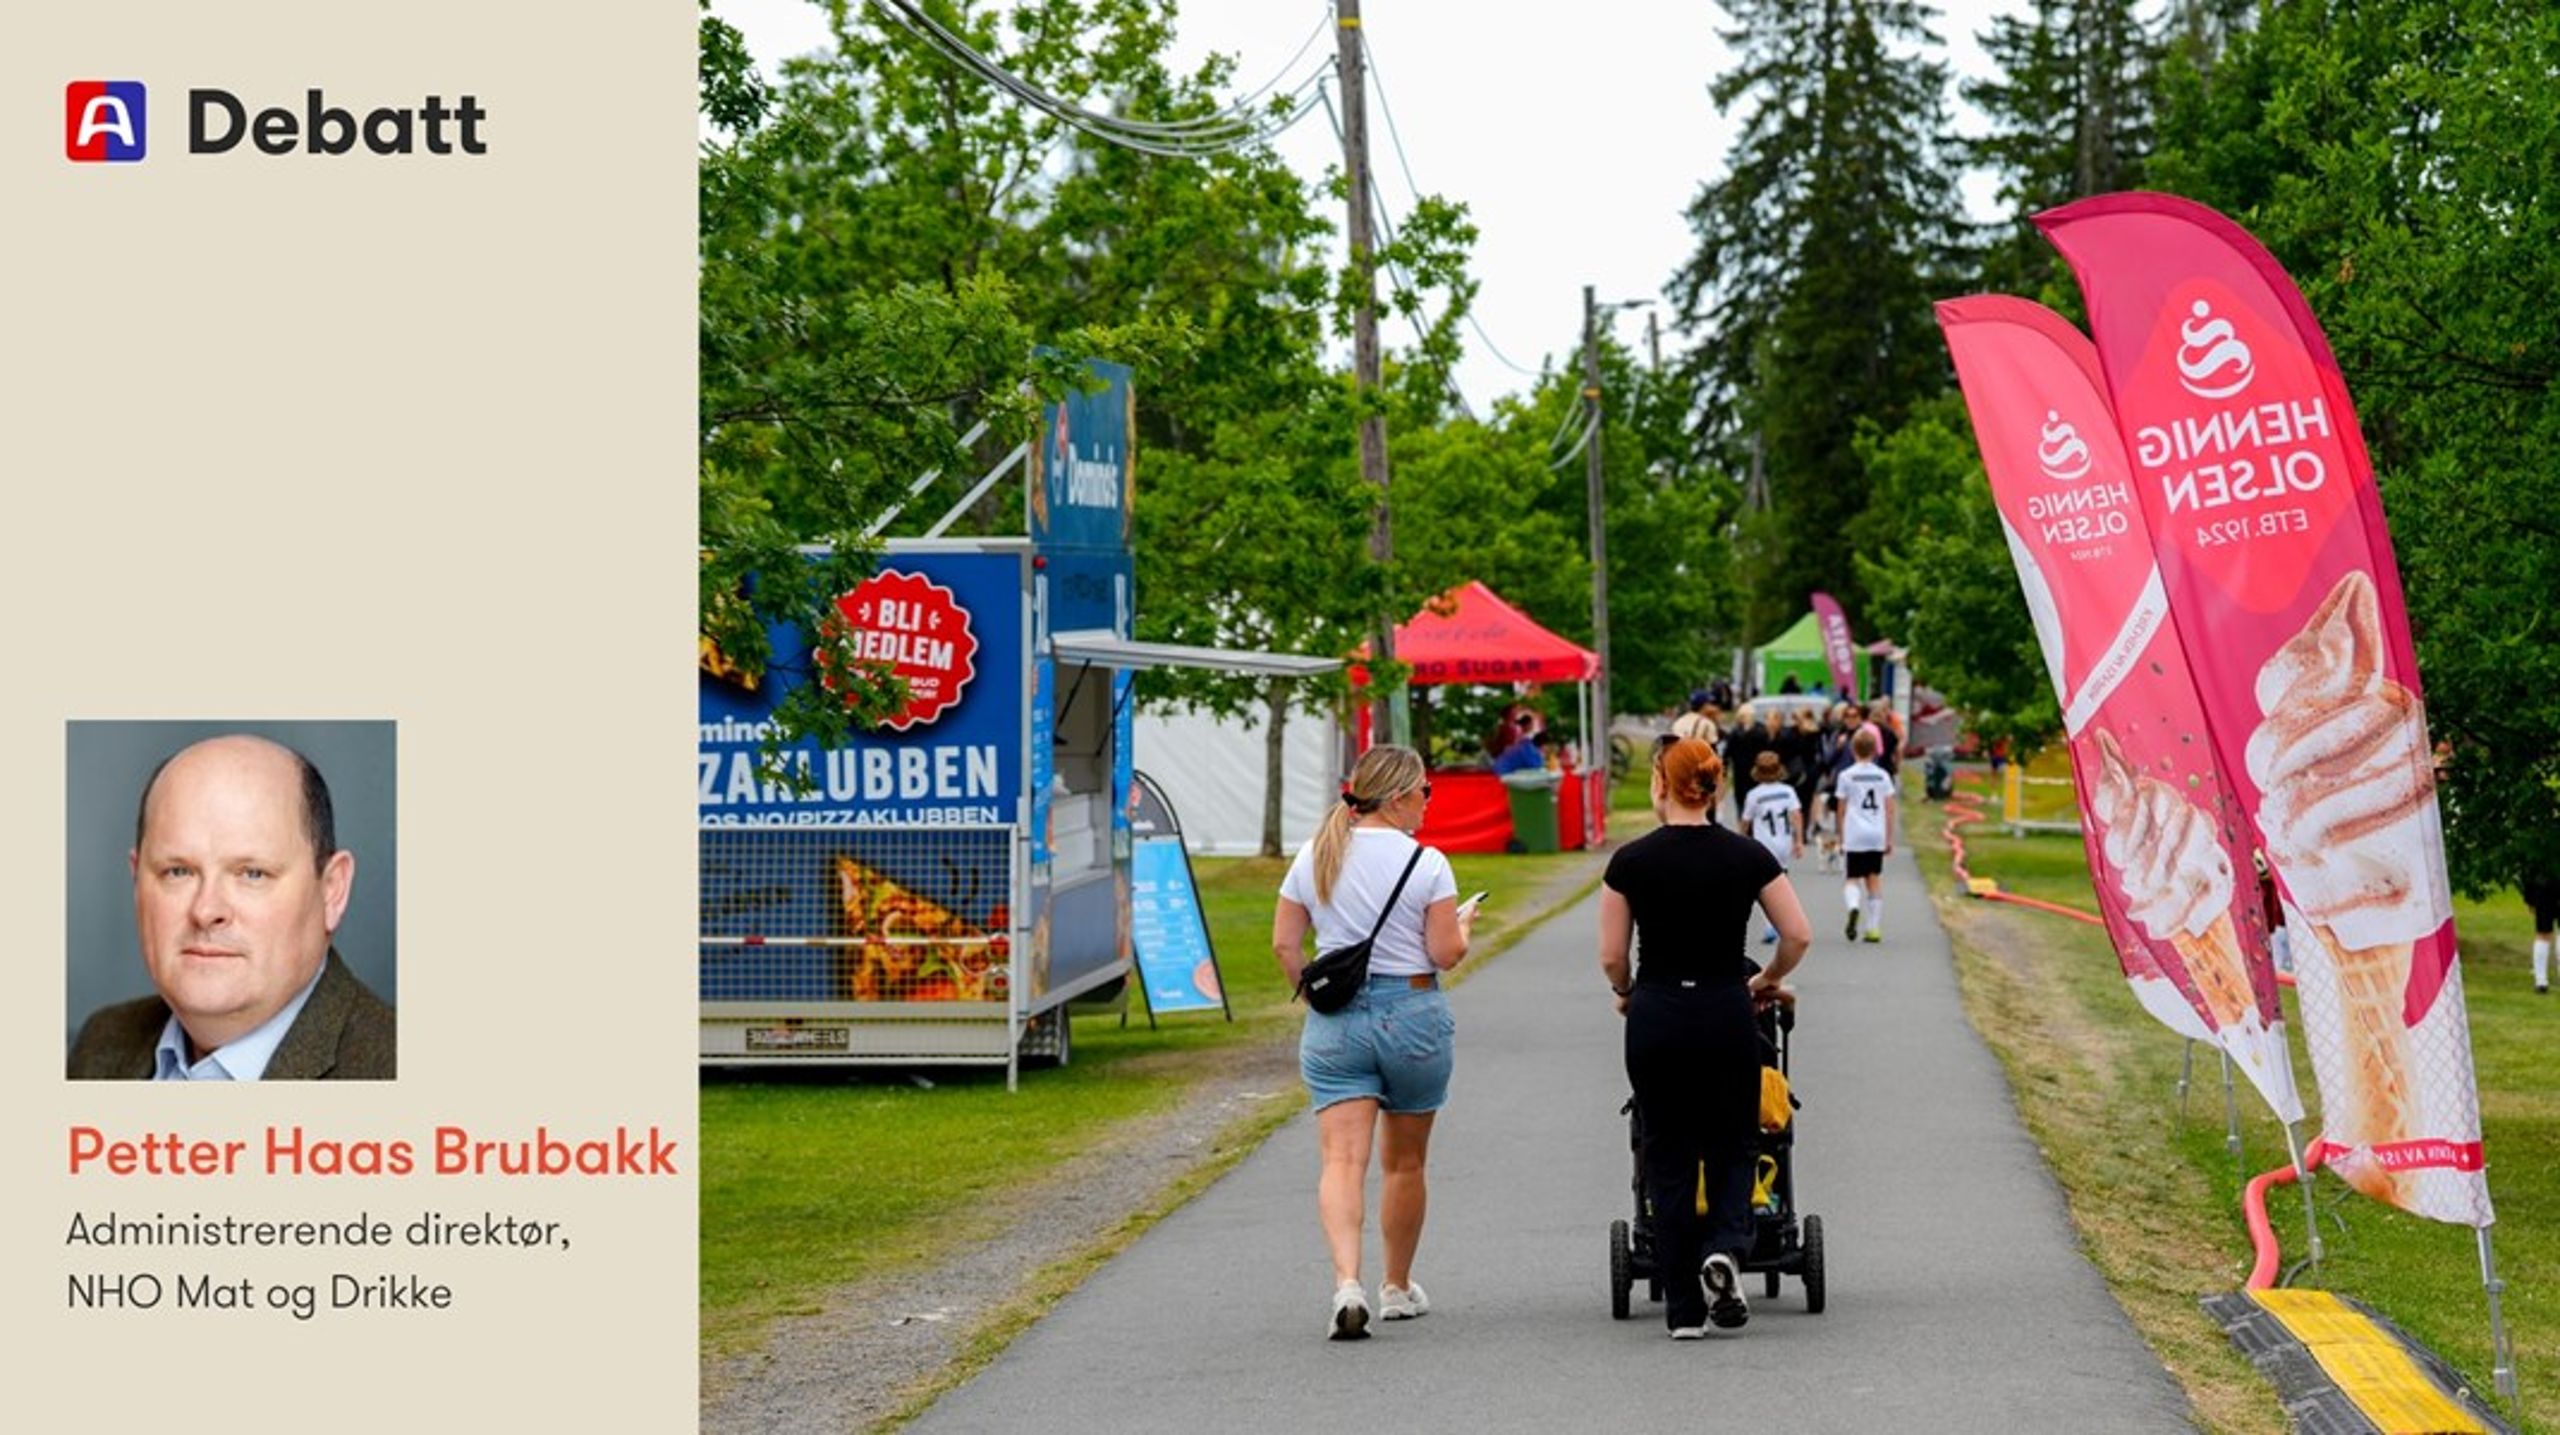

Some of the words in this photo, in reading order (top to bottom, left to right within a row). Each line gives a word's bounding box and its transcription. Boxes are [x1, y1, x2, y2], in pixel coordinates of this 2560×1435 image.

[878, 598, 922, 631] BLI
[1456, 657, 1544, 676] SUGAR
[1862, 788, 1878, 812] 4
[1762, 807, 1791, 837] 11
